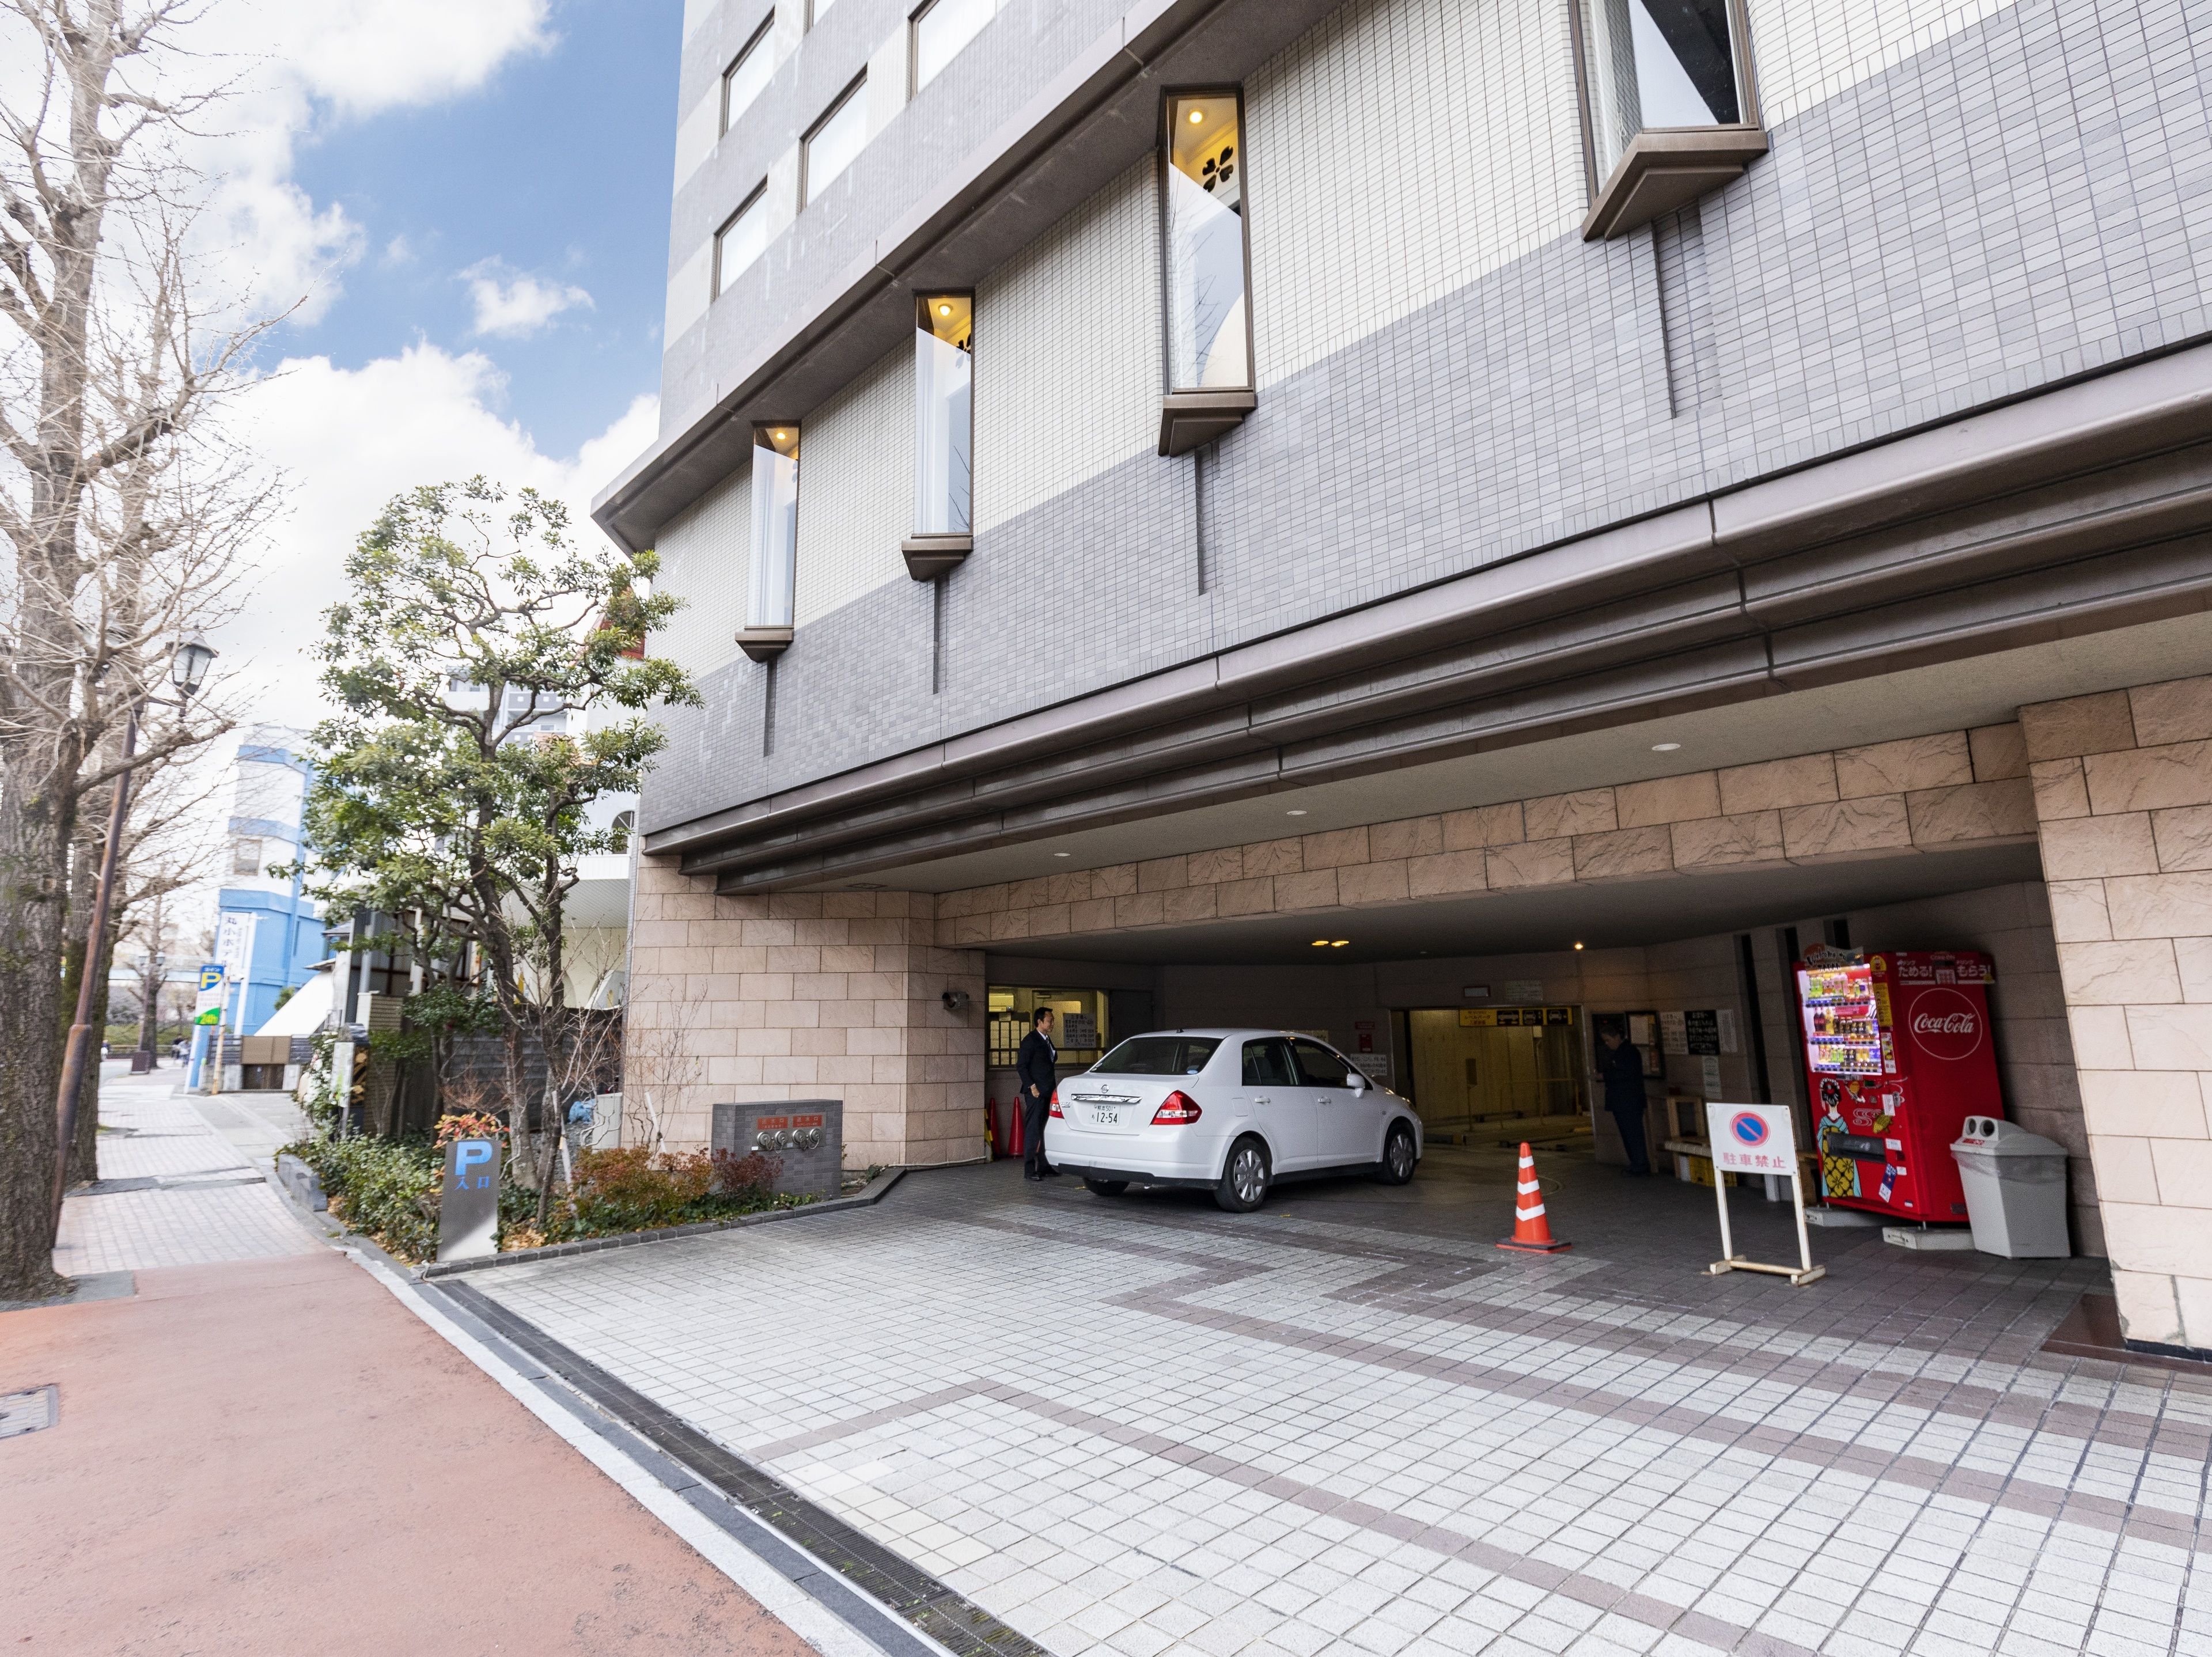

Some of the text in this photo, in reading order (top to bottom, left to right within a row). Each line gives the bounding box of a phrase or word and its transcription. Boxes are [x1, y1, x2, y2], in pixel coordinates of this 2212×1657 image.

[200, 972, 222, 989] P
[1914, 1013, 1976, 1033] Coca-Cola
[1097, 1112, 1118, 1124] 12-54
[455, 1141, 493, 1176] P
[1723, 1152, 1787, 1169] 駐車禁止
[454, 1177, 489, 1190] 入口
